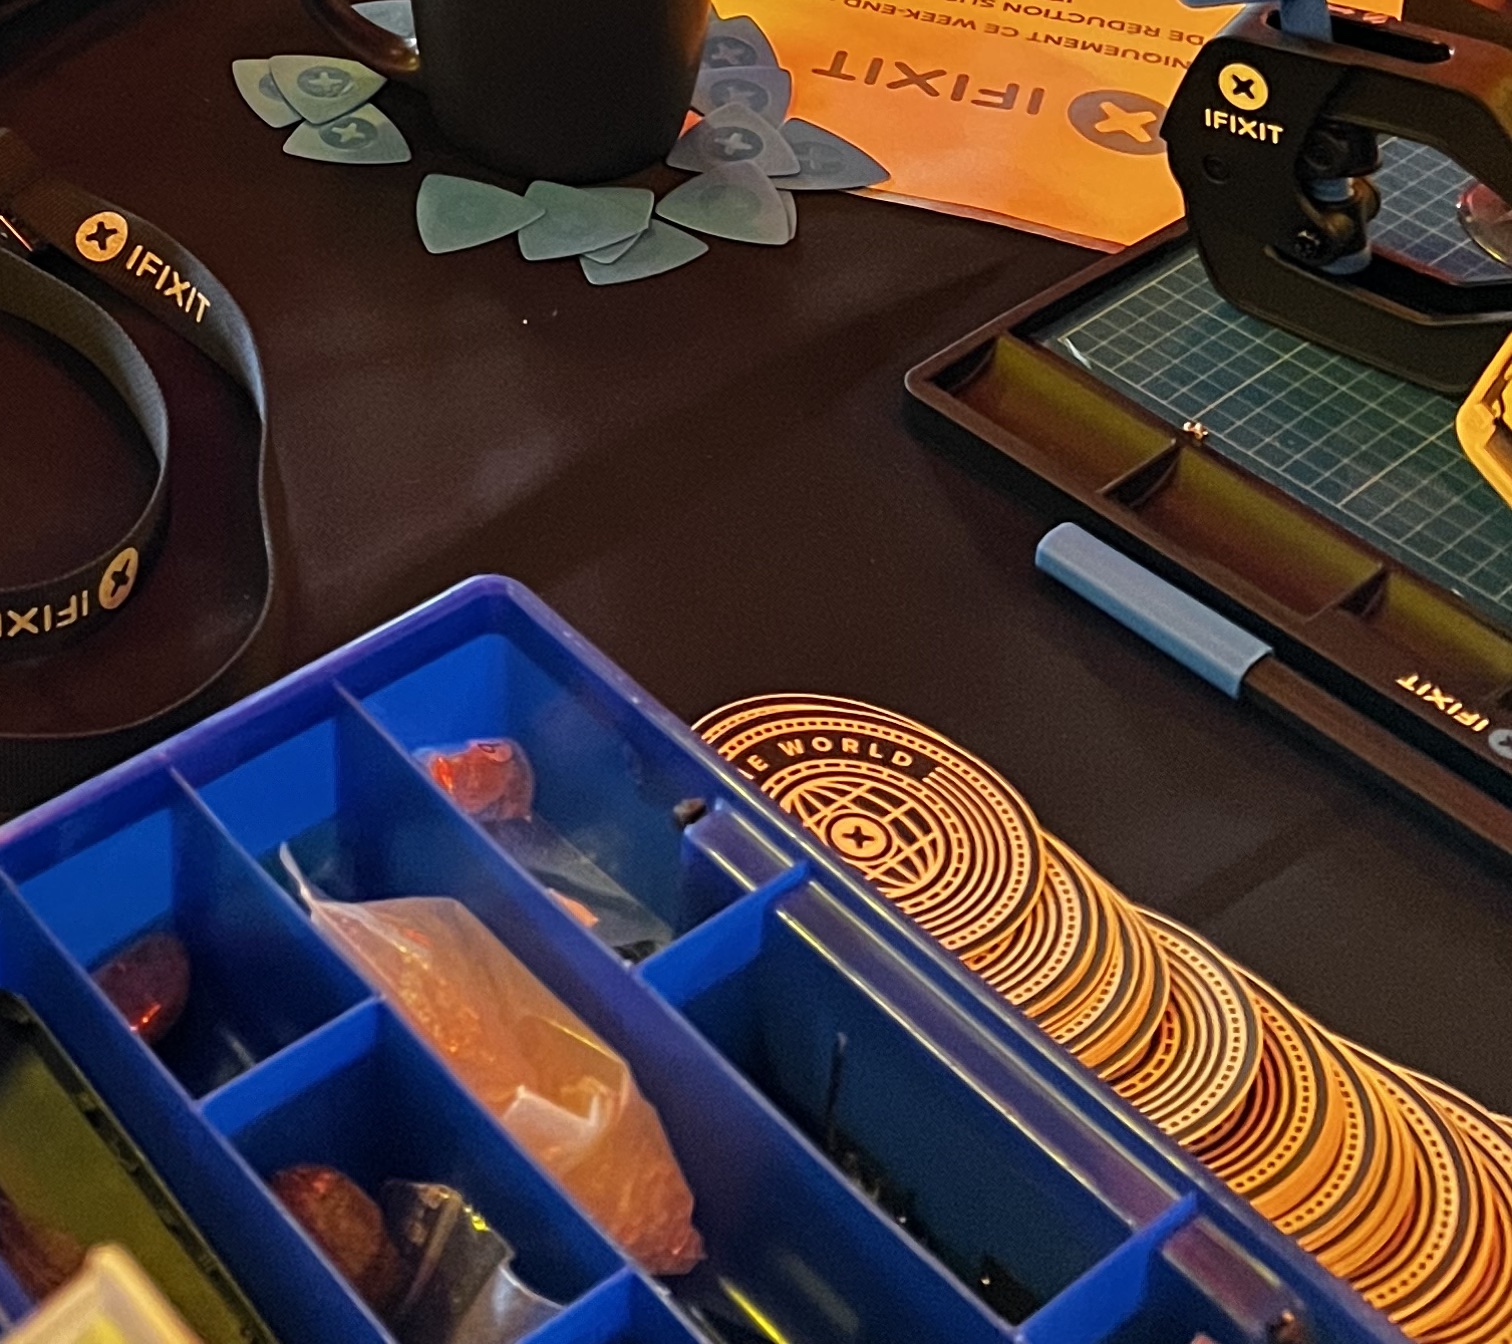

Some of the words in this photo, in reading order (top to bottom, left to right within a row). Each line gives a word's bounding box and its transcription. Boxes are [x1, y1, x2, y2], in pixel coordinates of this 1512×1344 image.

[983, 21, 1020, 39] CE
[1023, 26, 1193, 73] NIQUEMENT
[1167, 29, 1204, 45] DE
[809, 43, 1046, 120] IFIXIT
[1203, 106, 1284, 145] IFIXIT
[124, 243, 212, 323] IFIXIT
[1395, 672, 1492, 733] IFIXIT
[778, 736, 913, 767] WORLD
